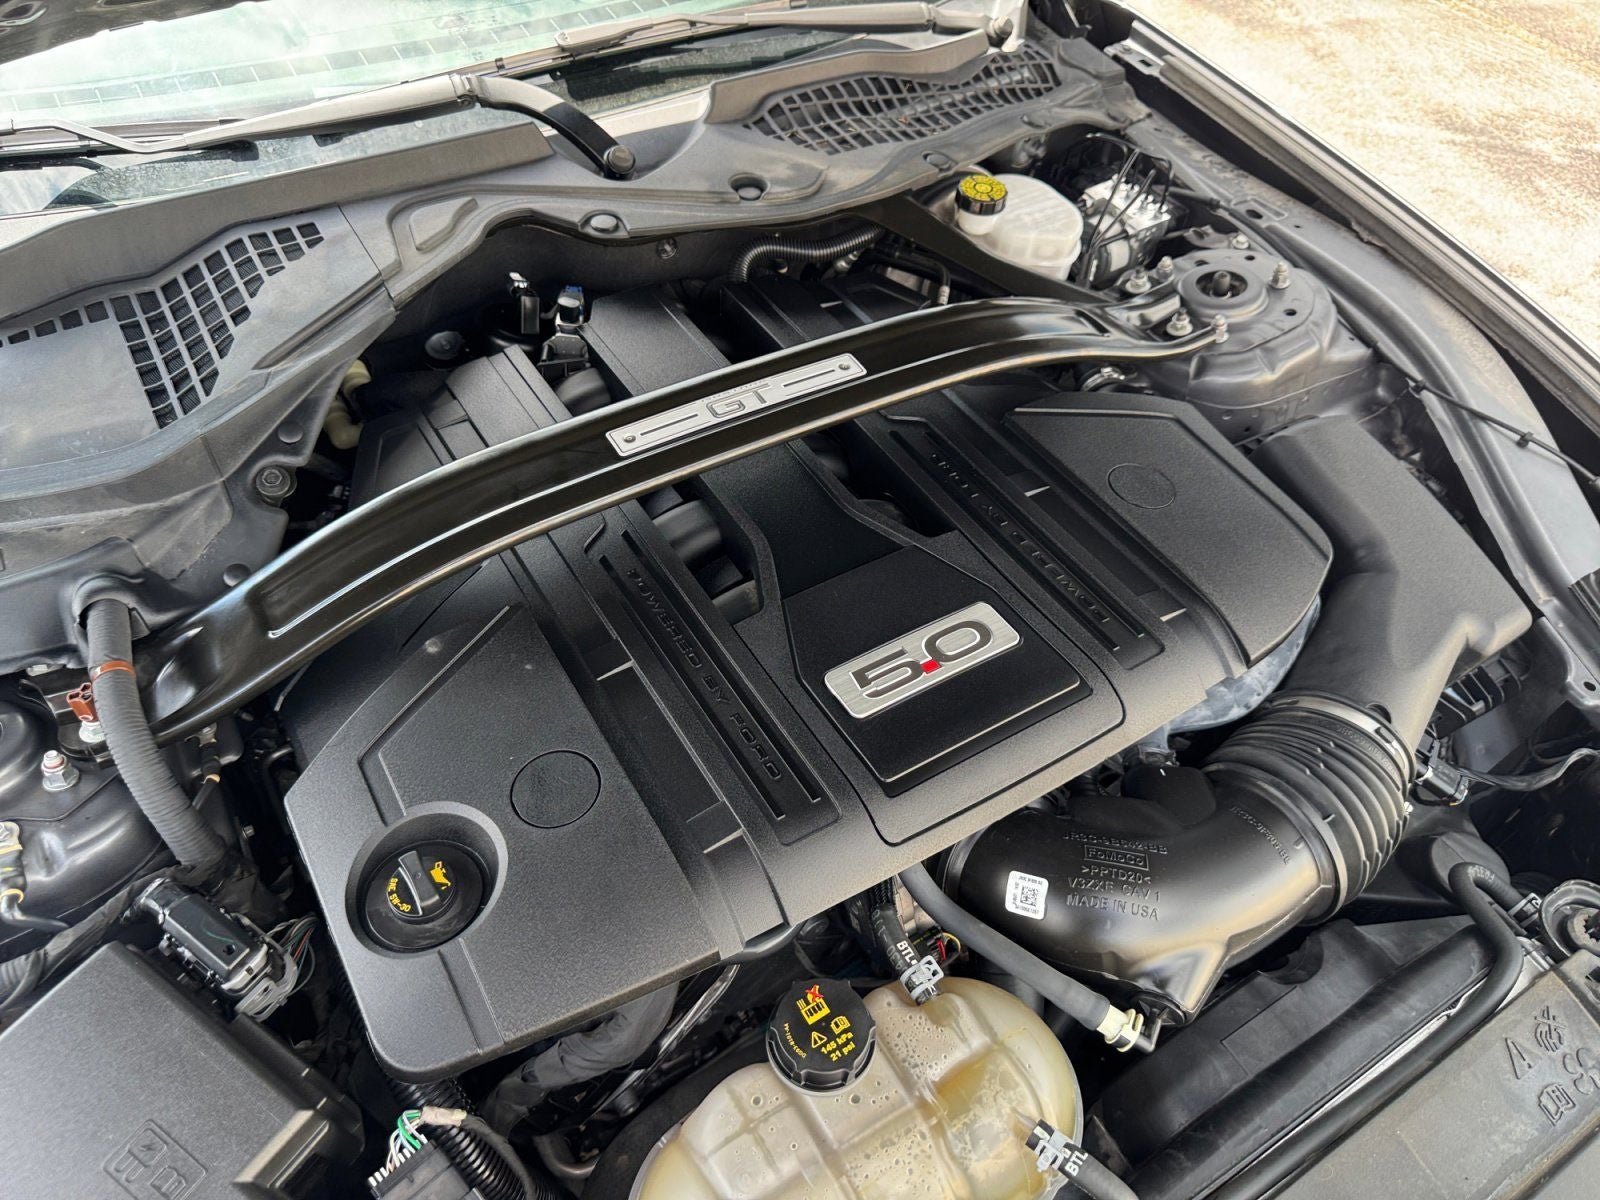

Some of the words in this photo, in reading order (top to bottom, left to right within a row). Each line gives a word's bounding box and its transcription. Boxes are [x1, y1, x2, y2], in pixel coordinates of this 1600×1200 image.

[706, 382, 772, 419] GT
[849, 620, 994, 699] 5.0
[702, 676, 730, 705] BY
[729, 712, 782, 781] FORD
[1088, 848, 1145, 866] FoMoCo
[387, 877, 398, 892] SAE
[1066, 892, 1109, 911] MADE
[1112, 899, 1127, 913] IN
[1131, 902, 1159, 920] USA
[821, 1040, 837, 1055] 145
[836, 1031, 854, 1046] kPa
[830, 1050, 842, 1062] 21
[842, 1041, 856, 1055] psi
[1065, 1150, 1089, 1177] BTL
